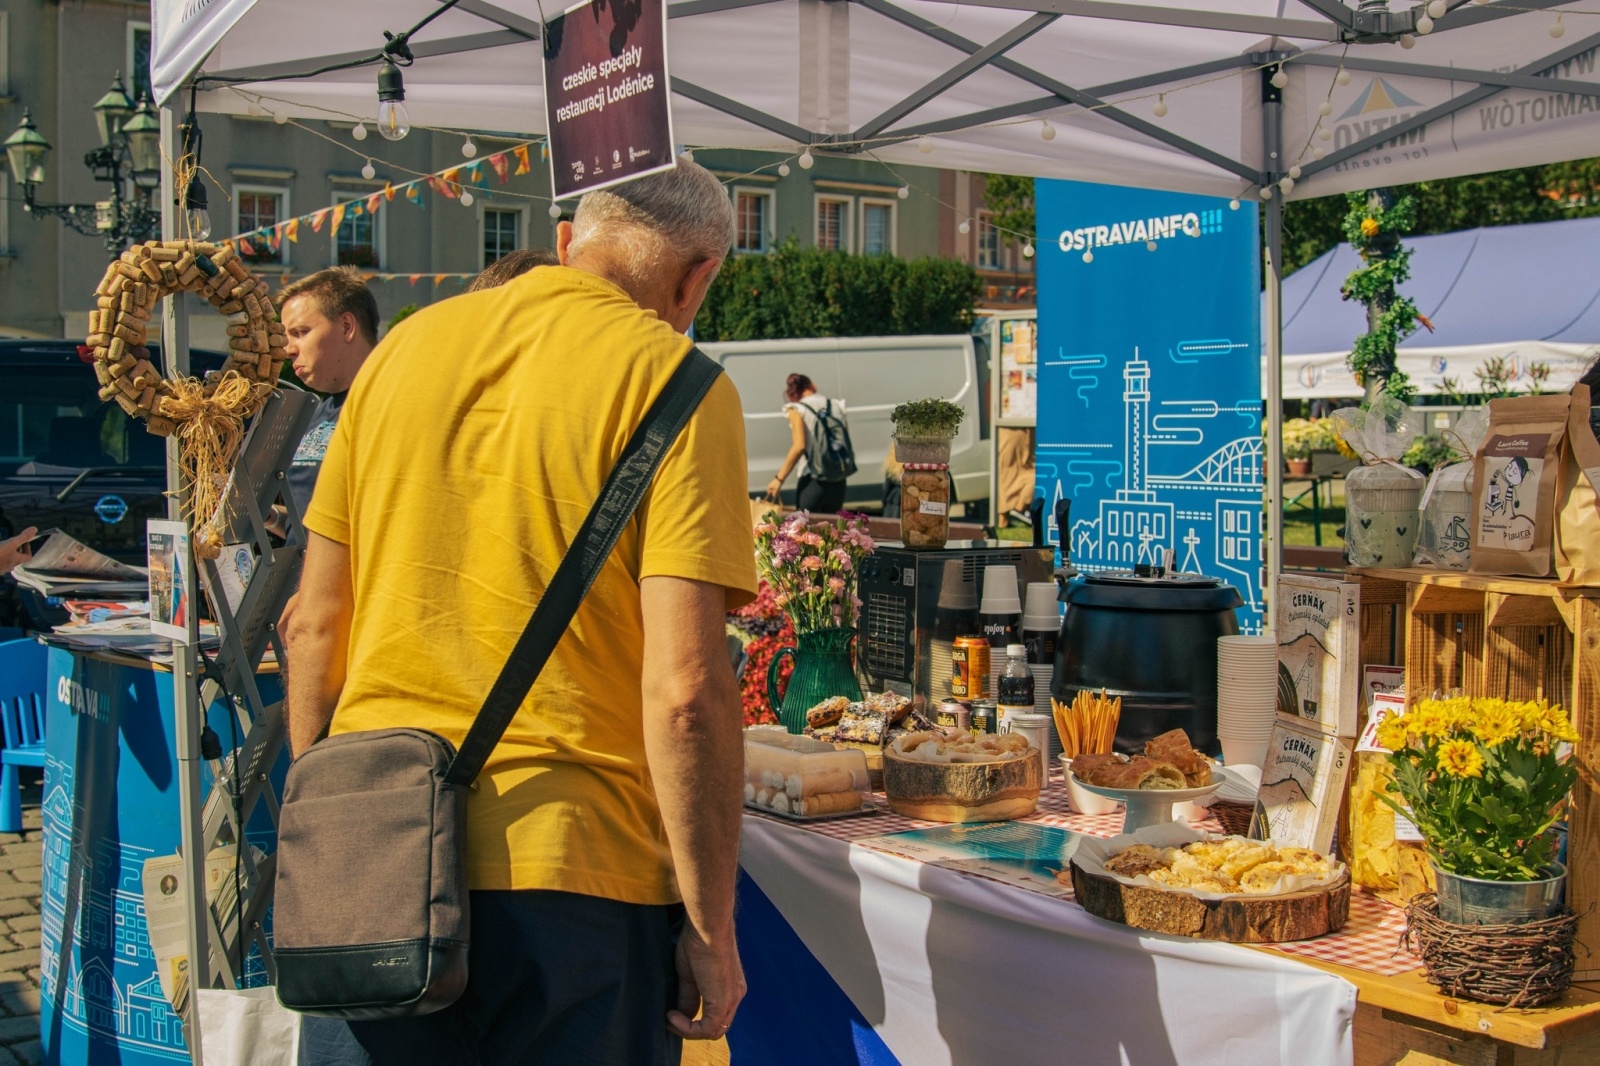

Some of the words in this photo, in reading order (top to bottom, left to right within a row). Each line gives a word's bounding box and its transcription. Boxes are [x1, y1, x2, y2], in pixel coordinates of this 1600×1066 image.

[563, 63, 597, 91] czeskie
[600, 46, 642, 79] specjały
[556, 88, 605, 123] restauracji
[607, 73, 654, 104] Loděnice
[1508, 529, 1531, 541] laura
[1292, 591, 1325, 613] ČERŇÁK
[984, 624, 1005, 635] kofola
[1284, 736, 1316, 761] ČERŇÁK
